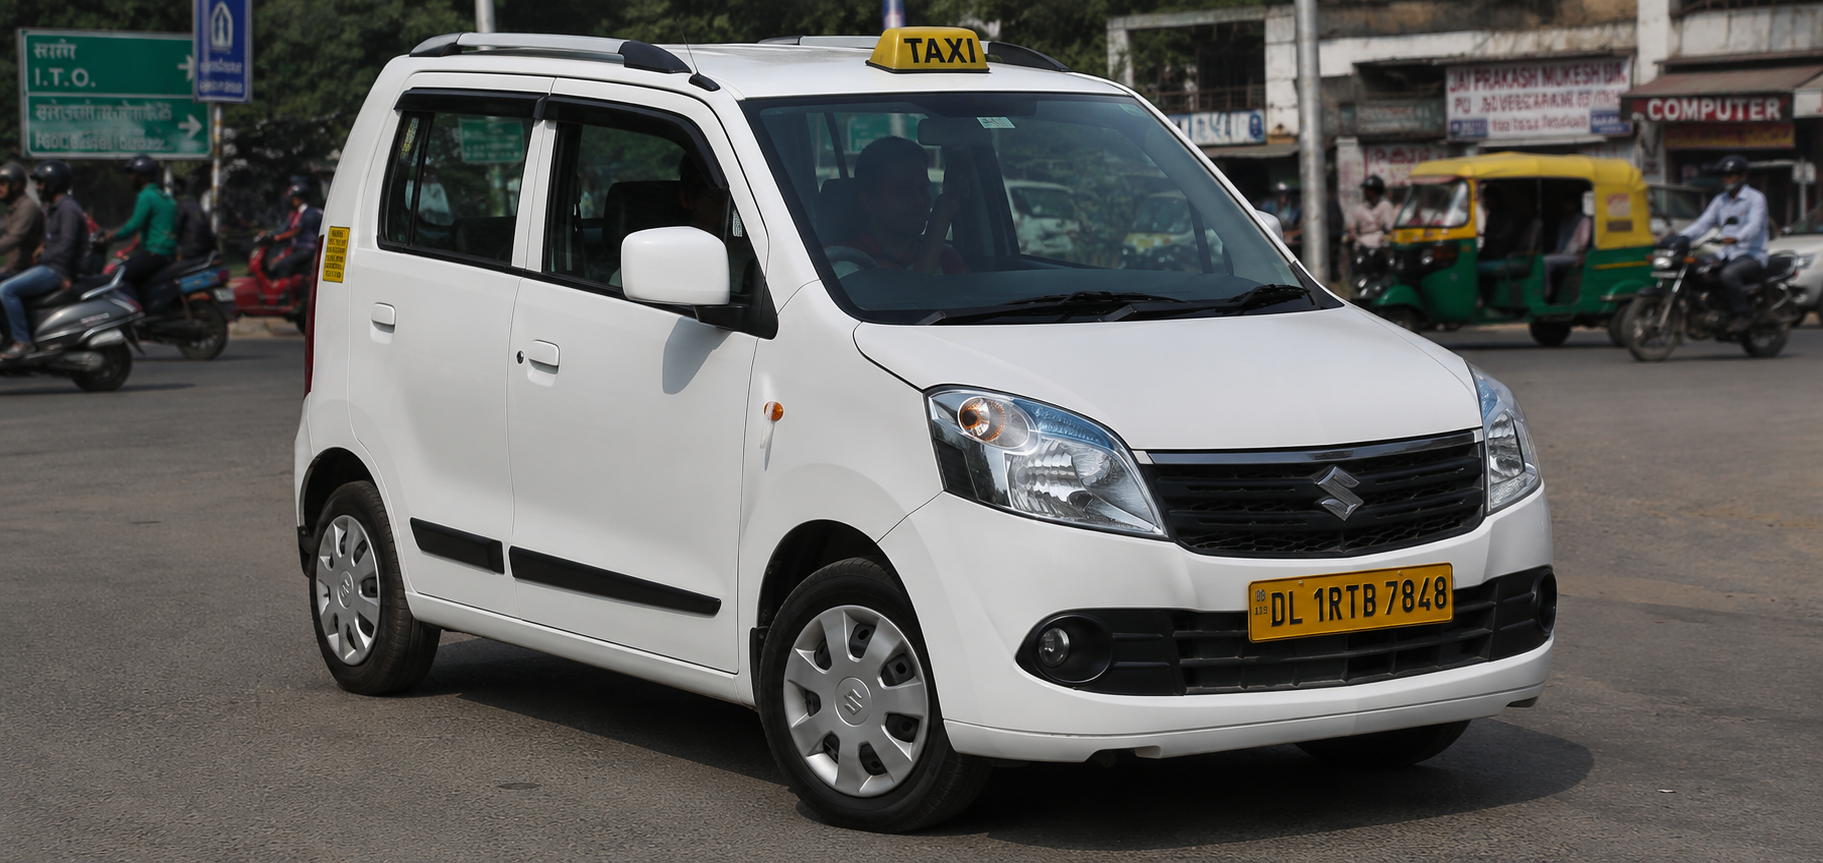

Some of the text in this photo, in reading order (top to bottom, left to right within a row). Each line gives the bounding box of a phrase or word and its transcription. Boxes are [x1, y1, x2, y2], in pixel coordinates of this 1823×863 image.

[903, 37, 977, 64] TAXI
[34, 67, 96, 88] I.T.O.
[1474, 65, 1538, 92] PRAKASH
[1542, 60, 1600, 87] MUKESH
[1647, 97, 1782, 122] COMPUTER
[1270, 575, 1447, 627] DL 1RTB 7848
